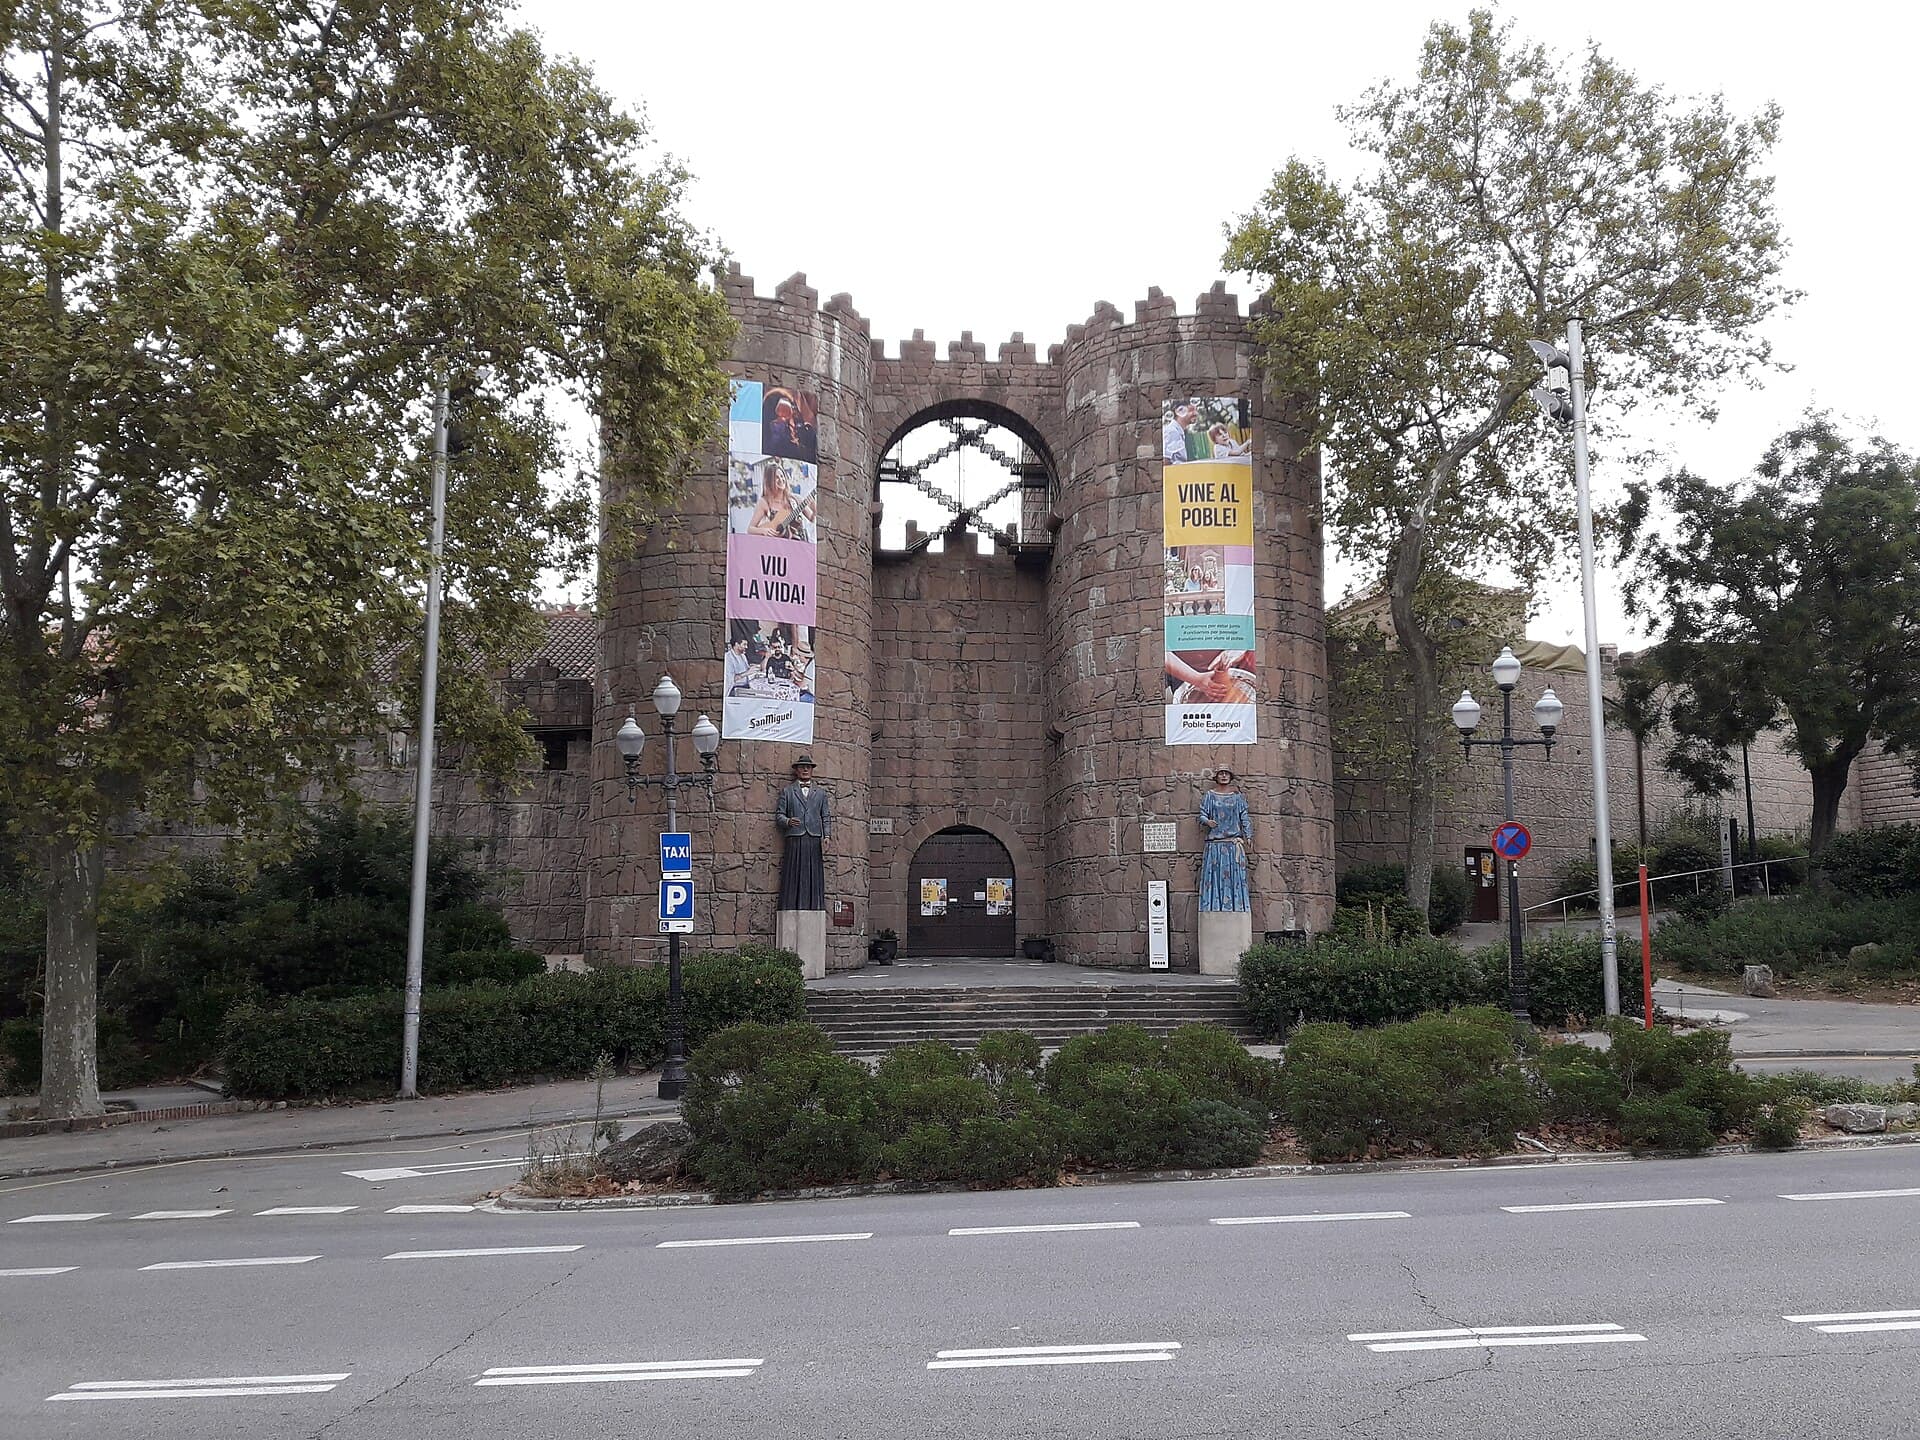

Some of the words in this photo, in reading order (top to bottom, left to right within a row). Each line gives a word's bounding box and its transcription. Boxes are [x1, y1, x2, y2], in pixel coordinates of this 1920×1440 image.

[1178, 483, 1215, 503] VINE
[1220, 483, 1240, 503] AL
[1181, 507, 1237, 527] POBLE!
[760, 555, 787, 577] VIU
[739, 578, 760, 599] LA
[764, 580, 805, 605] VIDA!
[1182, 720, 1205, 728] Poble
[1206, 720, 1241, 729] Espanyol
[663, 846, 689, 858] TAXI
[666, 885, 687, 915] P
